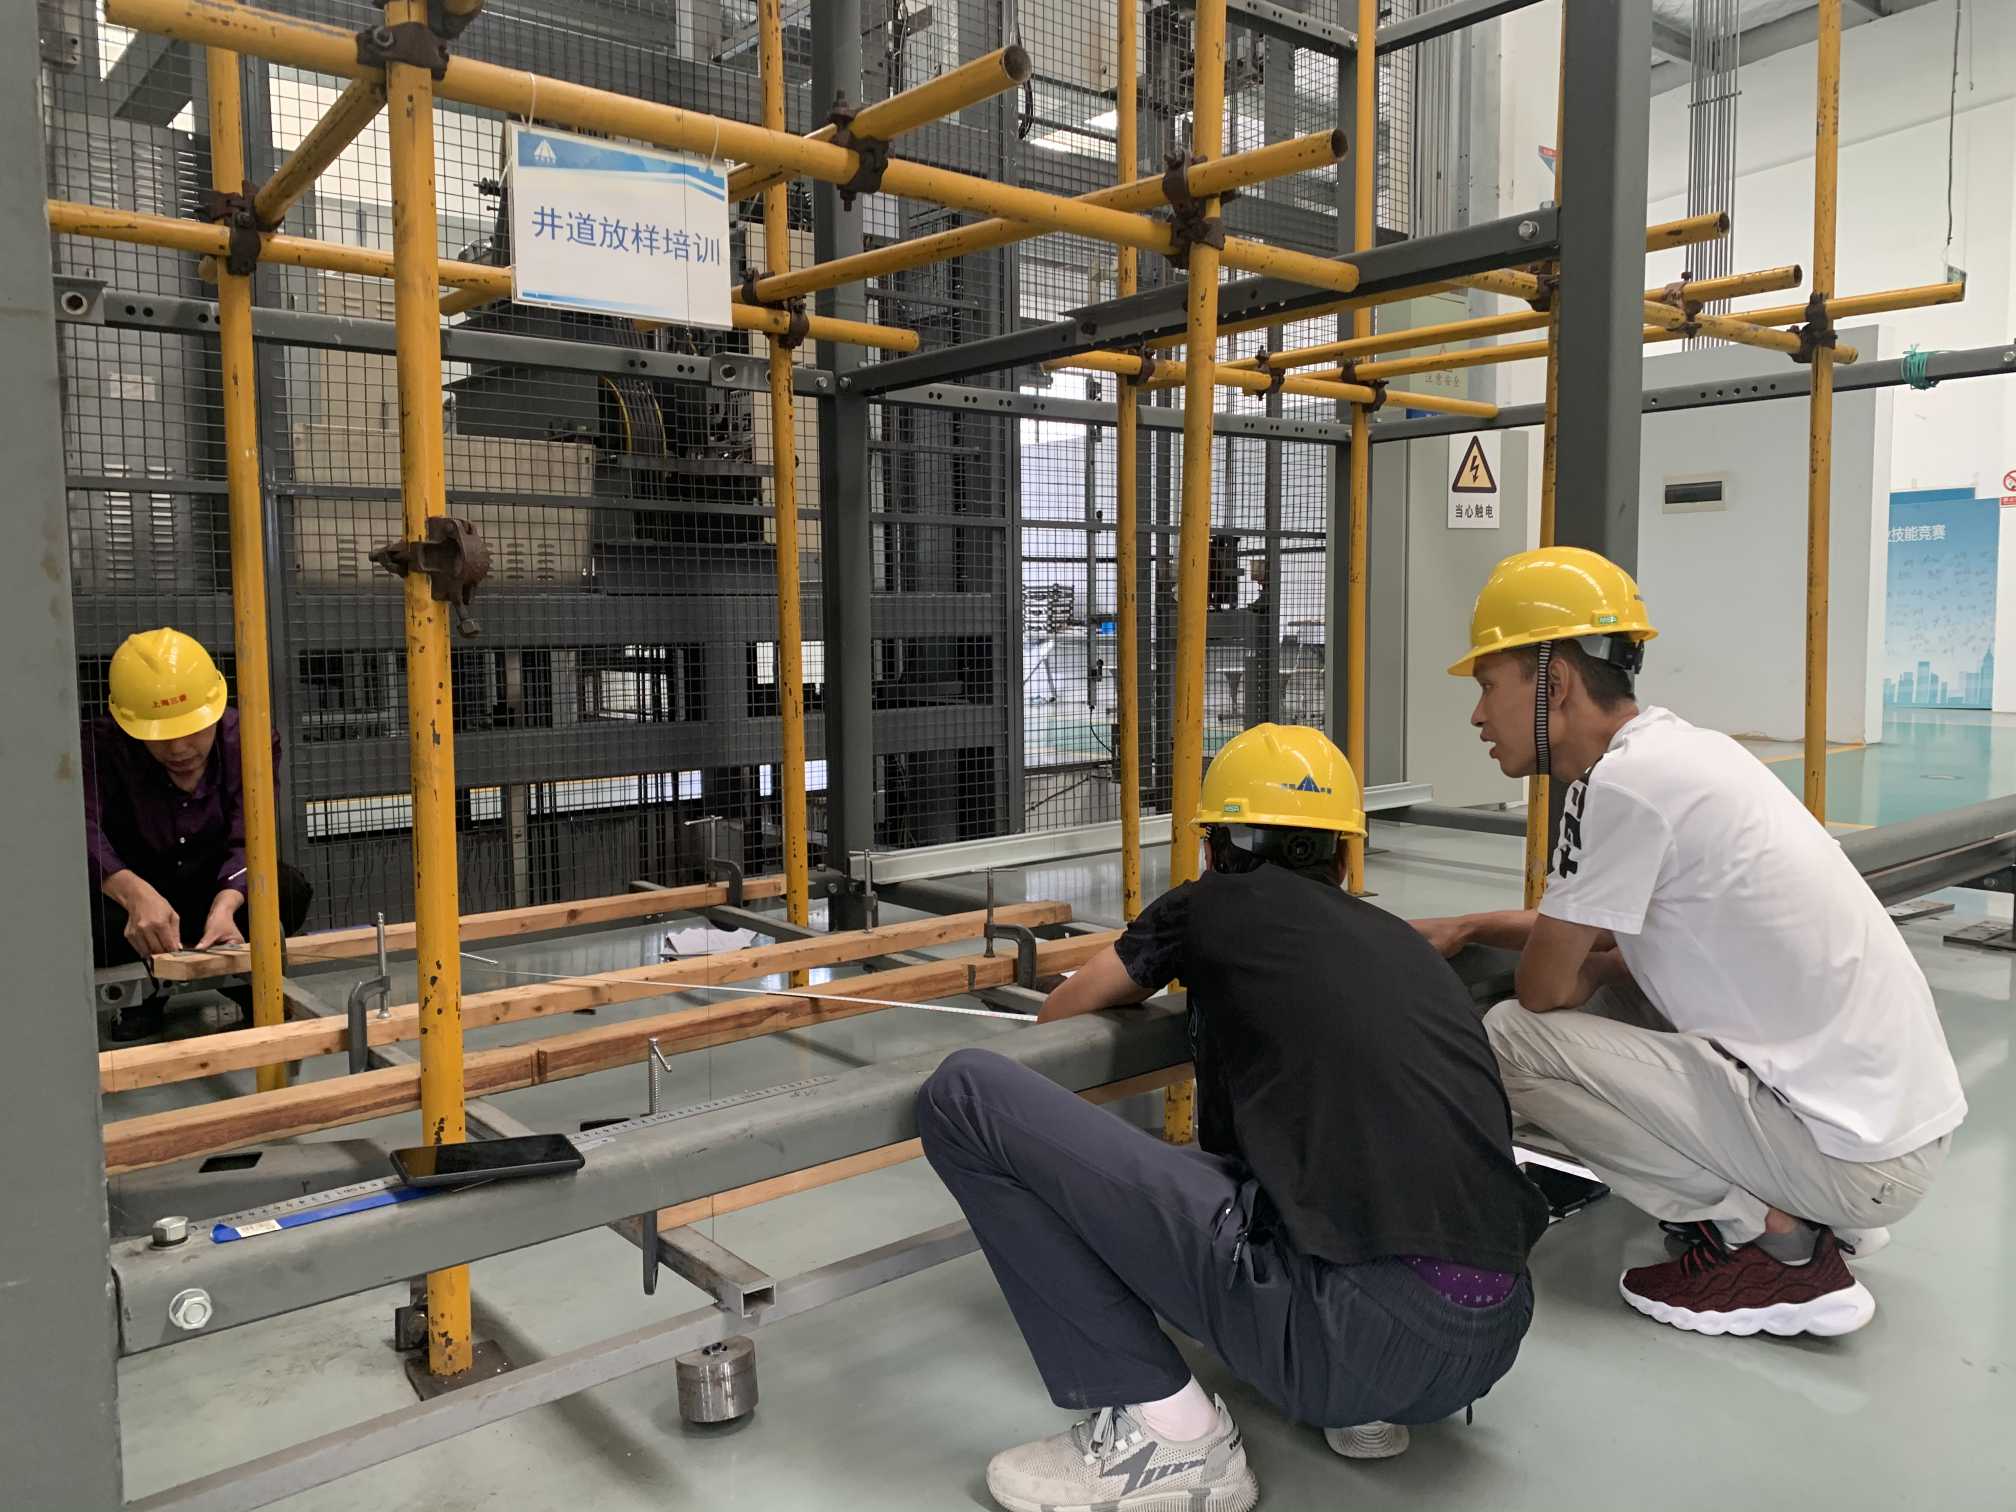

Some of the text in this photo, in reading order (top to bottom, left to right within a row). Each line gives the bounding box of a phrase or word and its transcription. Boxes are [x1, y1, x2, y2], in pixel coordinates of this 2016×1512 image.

[532, 205, 720, 265] 井道放样培训
[1455, 503, 1494, 519] 当心触电
